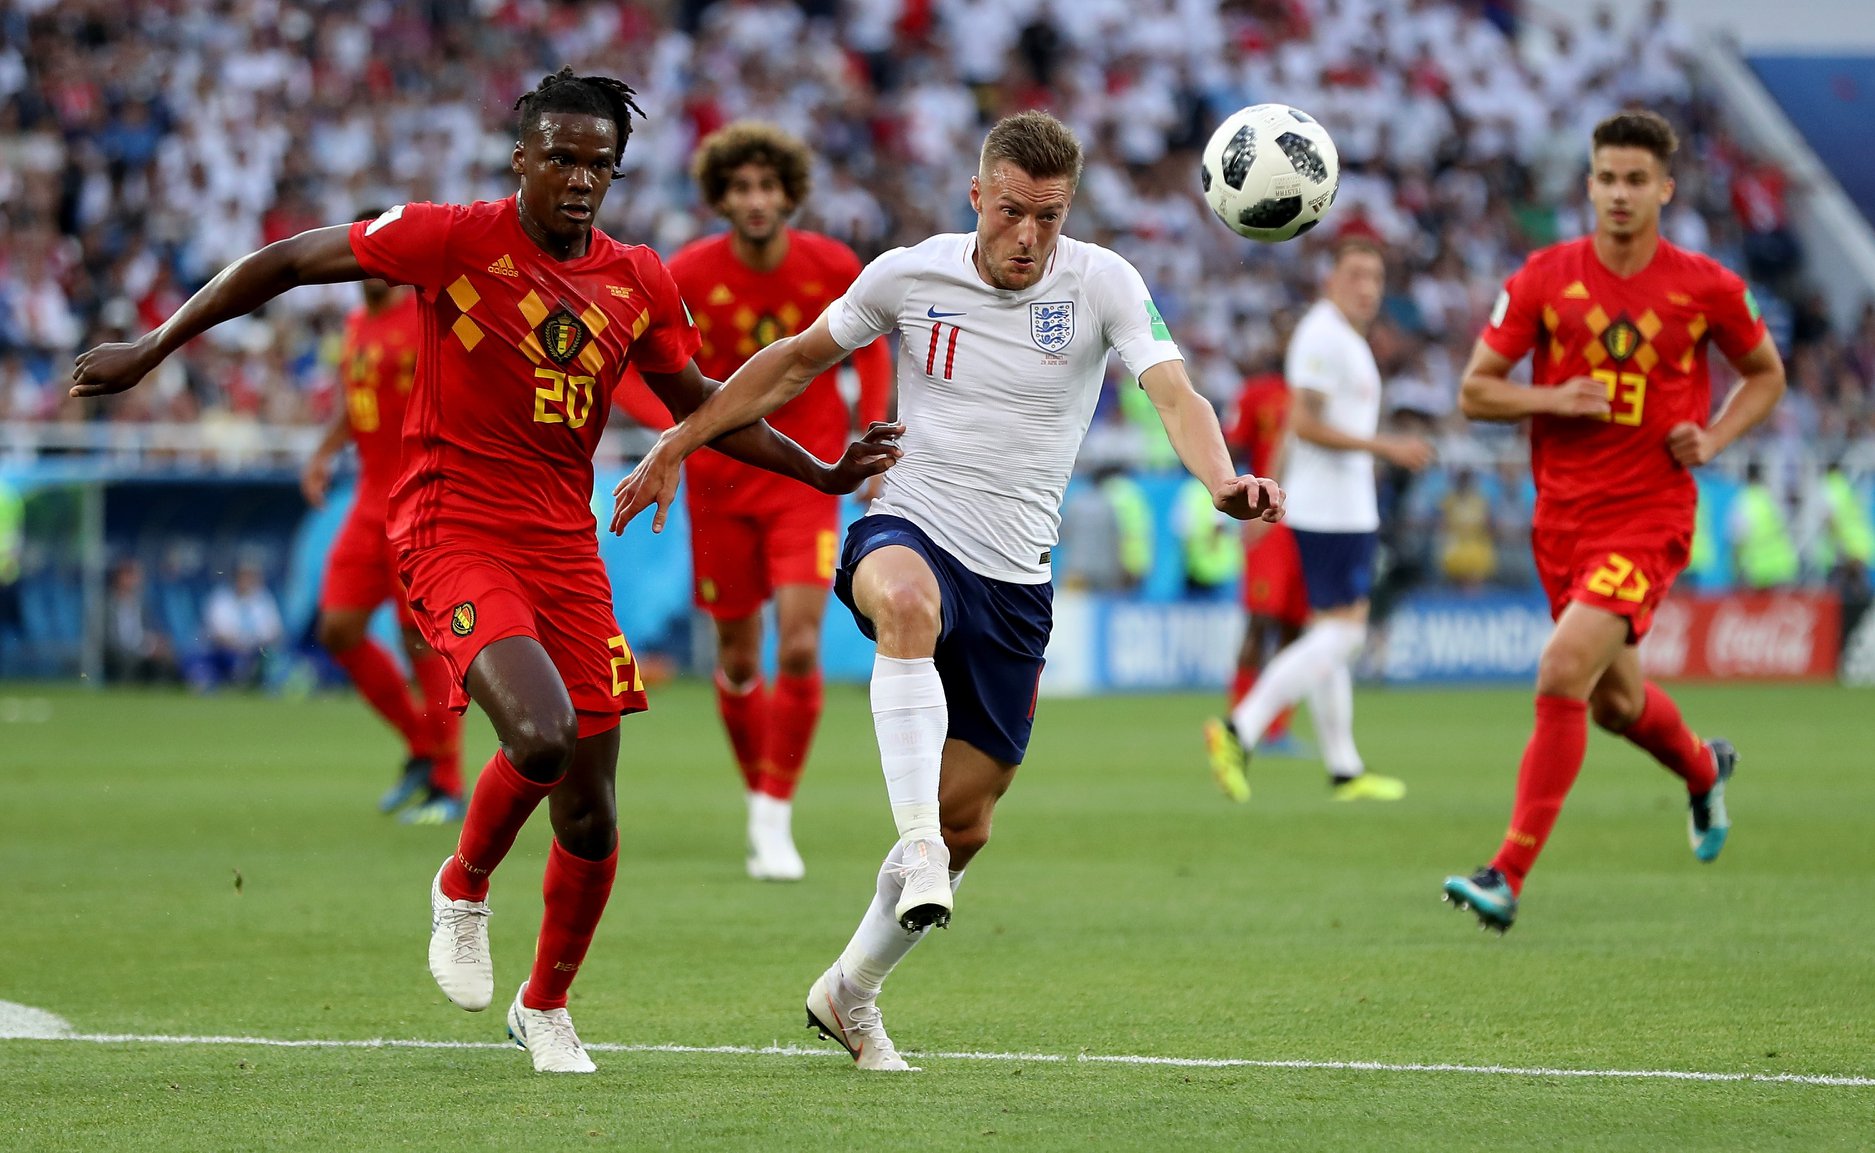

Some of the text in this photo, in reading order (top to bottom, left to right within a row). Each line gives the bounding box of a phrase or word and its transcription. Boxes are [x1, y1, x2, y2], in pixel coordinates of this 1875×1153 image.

[487, 266, 519, 278] adidas
[925, 321, 960, 380] 11
[533, 367, 596, 429] 20
[553, 961, 584, 972] BEL
